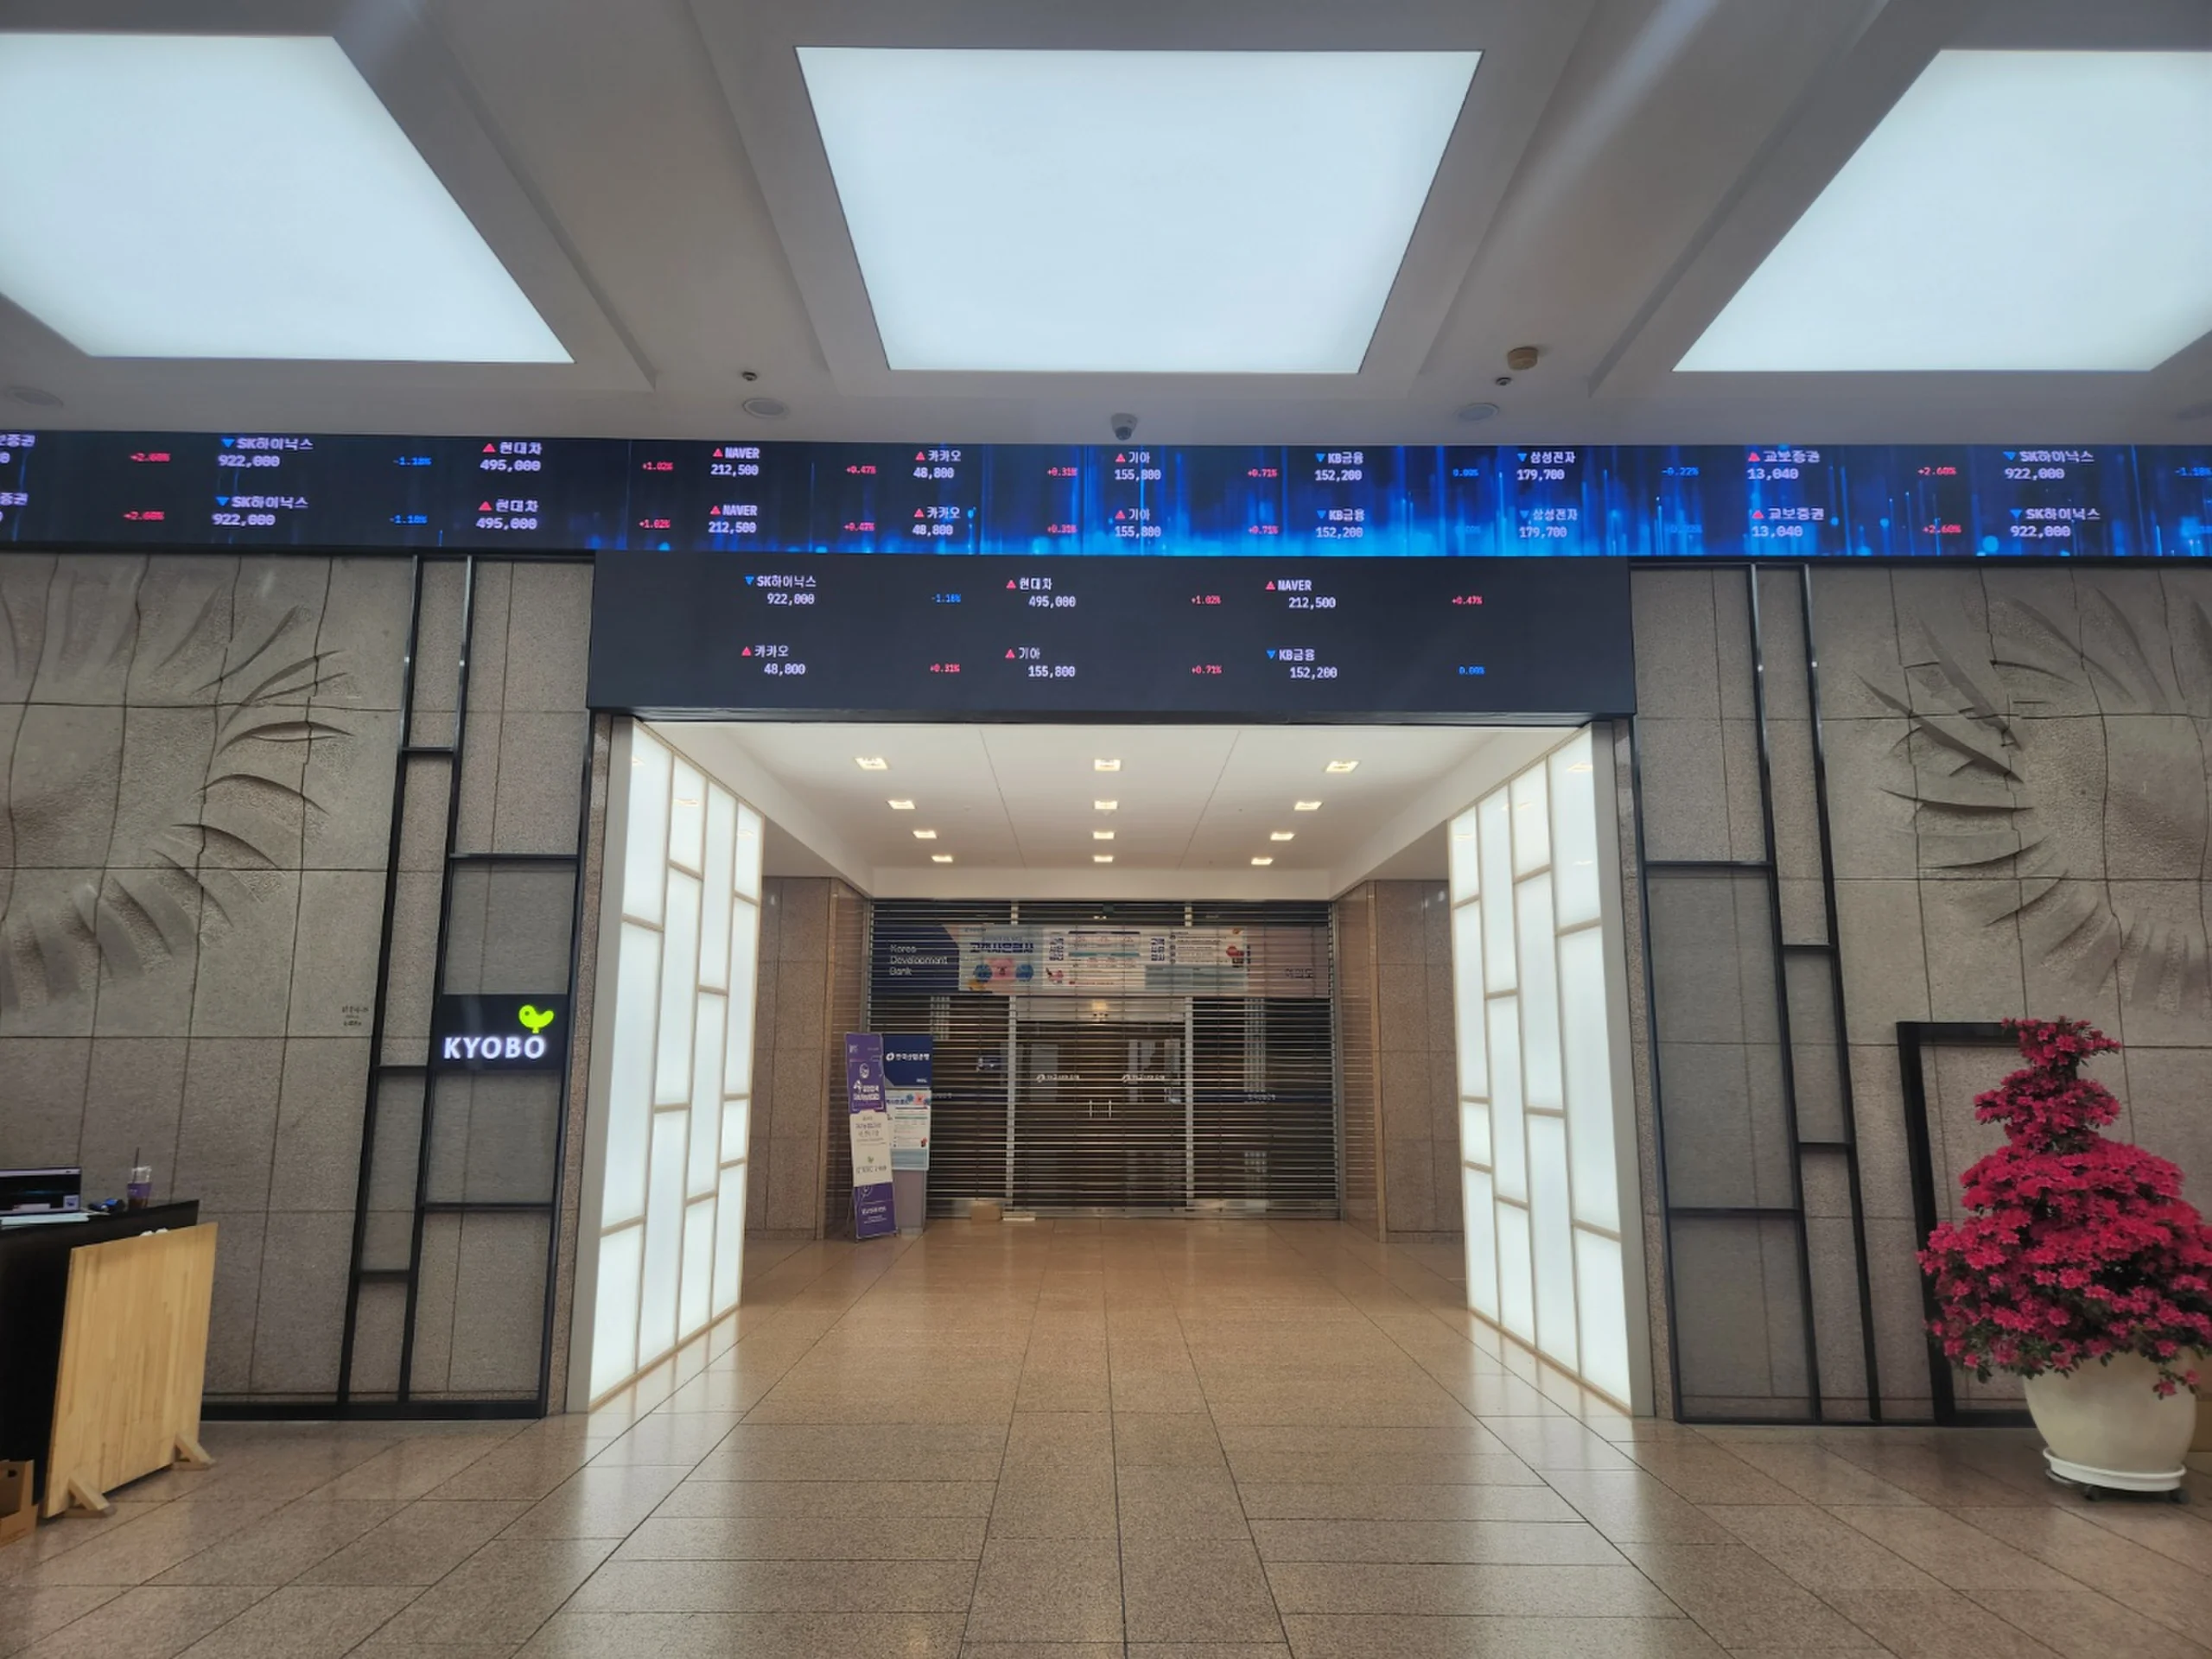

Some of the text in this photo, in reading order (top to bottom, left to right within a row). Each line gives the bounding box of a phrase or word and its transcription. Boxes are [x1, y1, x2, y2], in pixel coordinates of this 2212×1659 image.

[236, 437, 313, 450] SK하이닉스
[499, 442, 542, 455] 현대차
[725, 448, 760, 459] NAVER
[928, 450, 961, 462] 카카오
[1128, 452, 1150, 464] 기아
[1327, 452, 1363, 465] KB금융
[1530, 451, 1576, 464] 삼성전자
[1764, 450, 1820, 463] 교보증권
[2019, 450, 2094, 463] SK하이닉스
[218, 454, 280, 467] 922,000
[480, 459, 541, 472] 495,000
[710, 464, 759, 476] 212,500
[1315, 470, 1362, 481] 152,200
[1517, 469, 1565, 480] 179,700
[1747, 468, 1799, 480] 13,040
[2004, 467, 2065, 480] 922,000
[232, 496, 308, 509] SK하이닉스
[495, 499, 538, 512] 현대차
[722, 505, 758, 516] NAVER
[926, 507, 960, 519] 카카오
[1128, 509, 1150, 520] 기아
[1533, 508, 1578, 521] 삼성전자
[1768, 507, 1824, 520] 교보증권
[2025, 508, 2101, 520] SK하이닉스
[212, 513, 276, 526] 922,000
[475, 518, 537, 530] 495,000
[708, 522, 756, 534] 212,500
[1316, 527, 1363, 538] 152,200
[1519, 527, 1567, 538] 179,700
[1751, 525, 1803, 537] 13,040
[2010, 525, 2071, 537] 922,000
[756, 575, 817, 588] SK하이닉스
[1019, 578, 1053, 590] 현대차
[1277, 580, 1312, 591] NAVER
[766, 593, 815, 605] 922,000
[1028, 596, 1077, 607] 495,000
[1288, 597, 1336, 608] 212,500
[753, 645, 790, 658] 카카오
[1018, 647, 1041, 659] 기아
[1279, 649, 1315, 662] KB금융
[764, 664, 806, 676] 48,800
[1027, 666, 1076, 677] 155,800
[1290, 667, 1338, 679] 152,200
[443, 1037, 546, 1059] KYOBO
